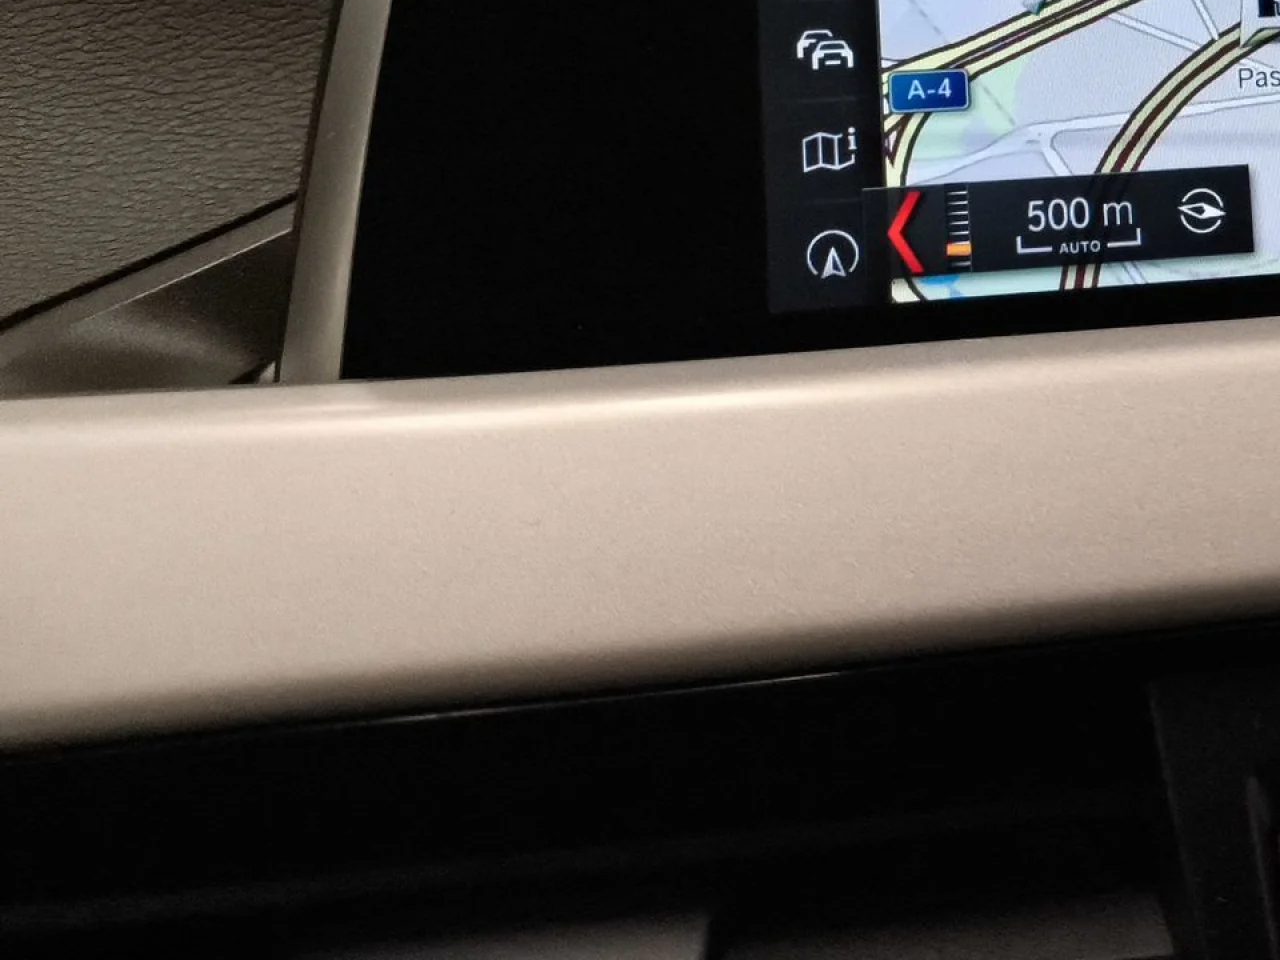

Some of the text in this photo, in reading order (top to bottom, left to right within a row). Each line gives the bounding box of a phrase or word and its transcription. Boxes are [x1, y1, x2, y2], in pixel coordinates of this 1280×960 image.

[907, 79, 952, 100] A-4
[1026, 197, 1134, 233] 500 m
[1059, 240, 1101, 255] AUTO
